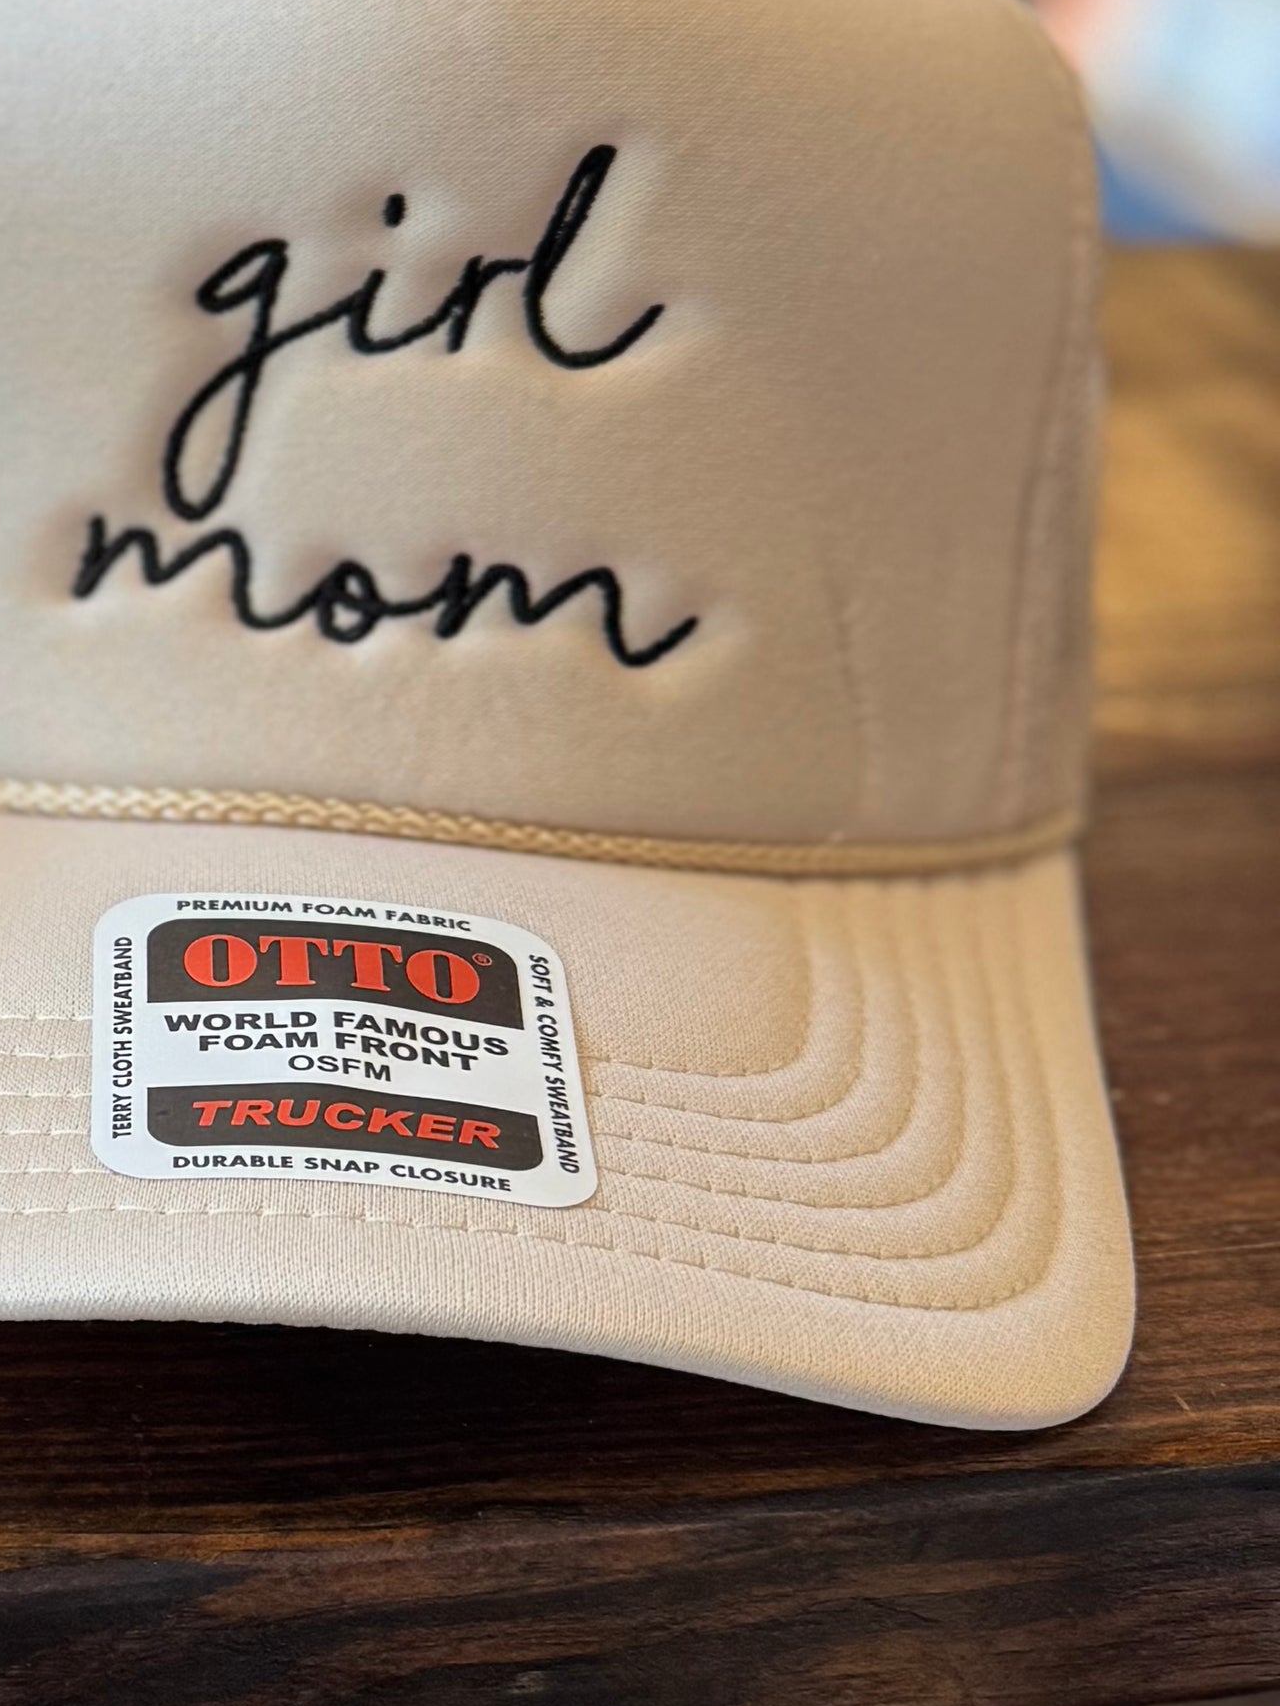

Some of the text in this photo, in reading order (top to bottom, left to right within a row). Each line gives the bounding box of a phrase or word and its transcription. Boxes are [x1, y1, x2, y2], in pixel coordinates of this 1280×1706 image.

[163, 144, 665, 522] girl
[72, 515, 698, 667] mom
[176, 899, 471, 932] PREMIUM FOAM FABRIC
[112, 936, 133, 1139] TERRY CLOTH SWEATBAND
[163, 1011, 509, 1056] WORLD FAMOUS
[199, 1032, 479, 1071] FOAM FRONT
[288, 1054, 392, 1082] OSFM
[528, 953, 580, 1175] SOFT & COMFY SWEATBAND
[192, 1100, 501, 1149] TRUCKER
[172, 1153, 512, 1192] DURABLE SNAP CLOSURE
